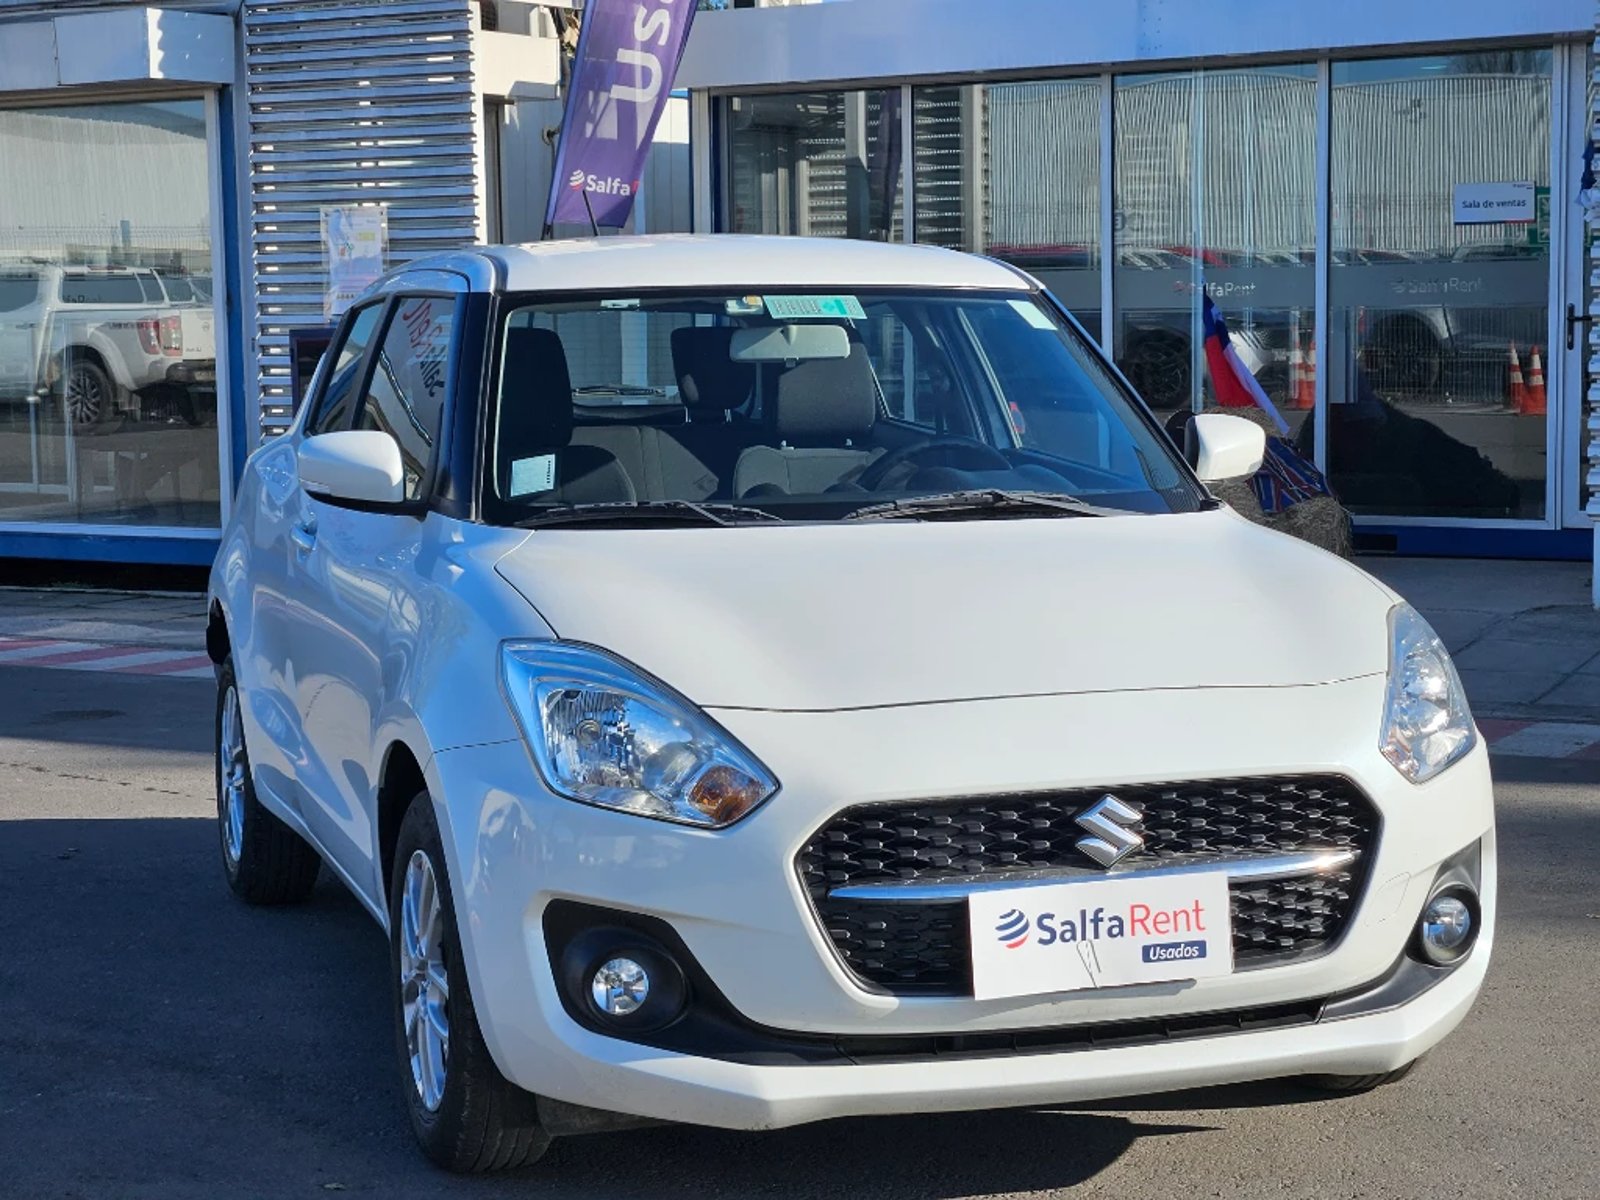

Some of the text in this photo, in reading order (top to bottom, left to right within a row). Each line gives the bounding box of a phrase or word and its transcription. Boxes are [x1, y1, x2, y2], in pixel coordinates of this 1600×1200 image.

[609, 0, 673, 103] Us
[1462, 198, 1527, 209] Sala de ventas
[1149, 944, 1200, 961] Usados
